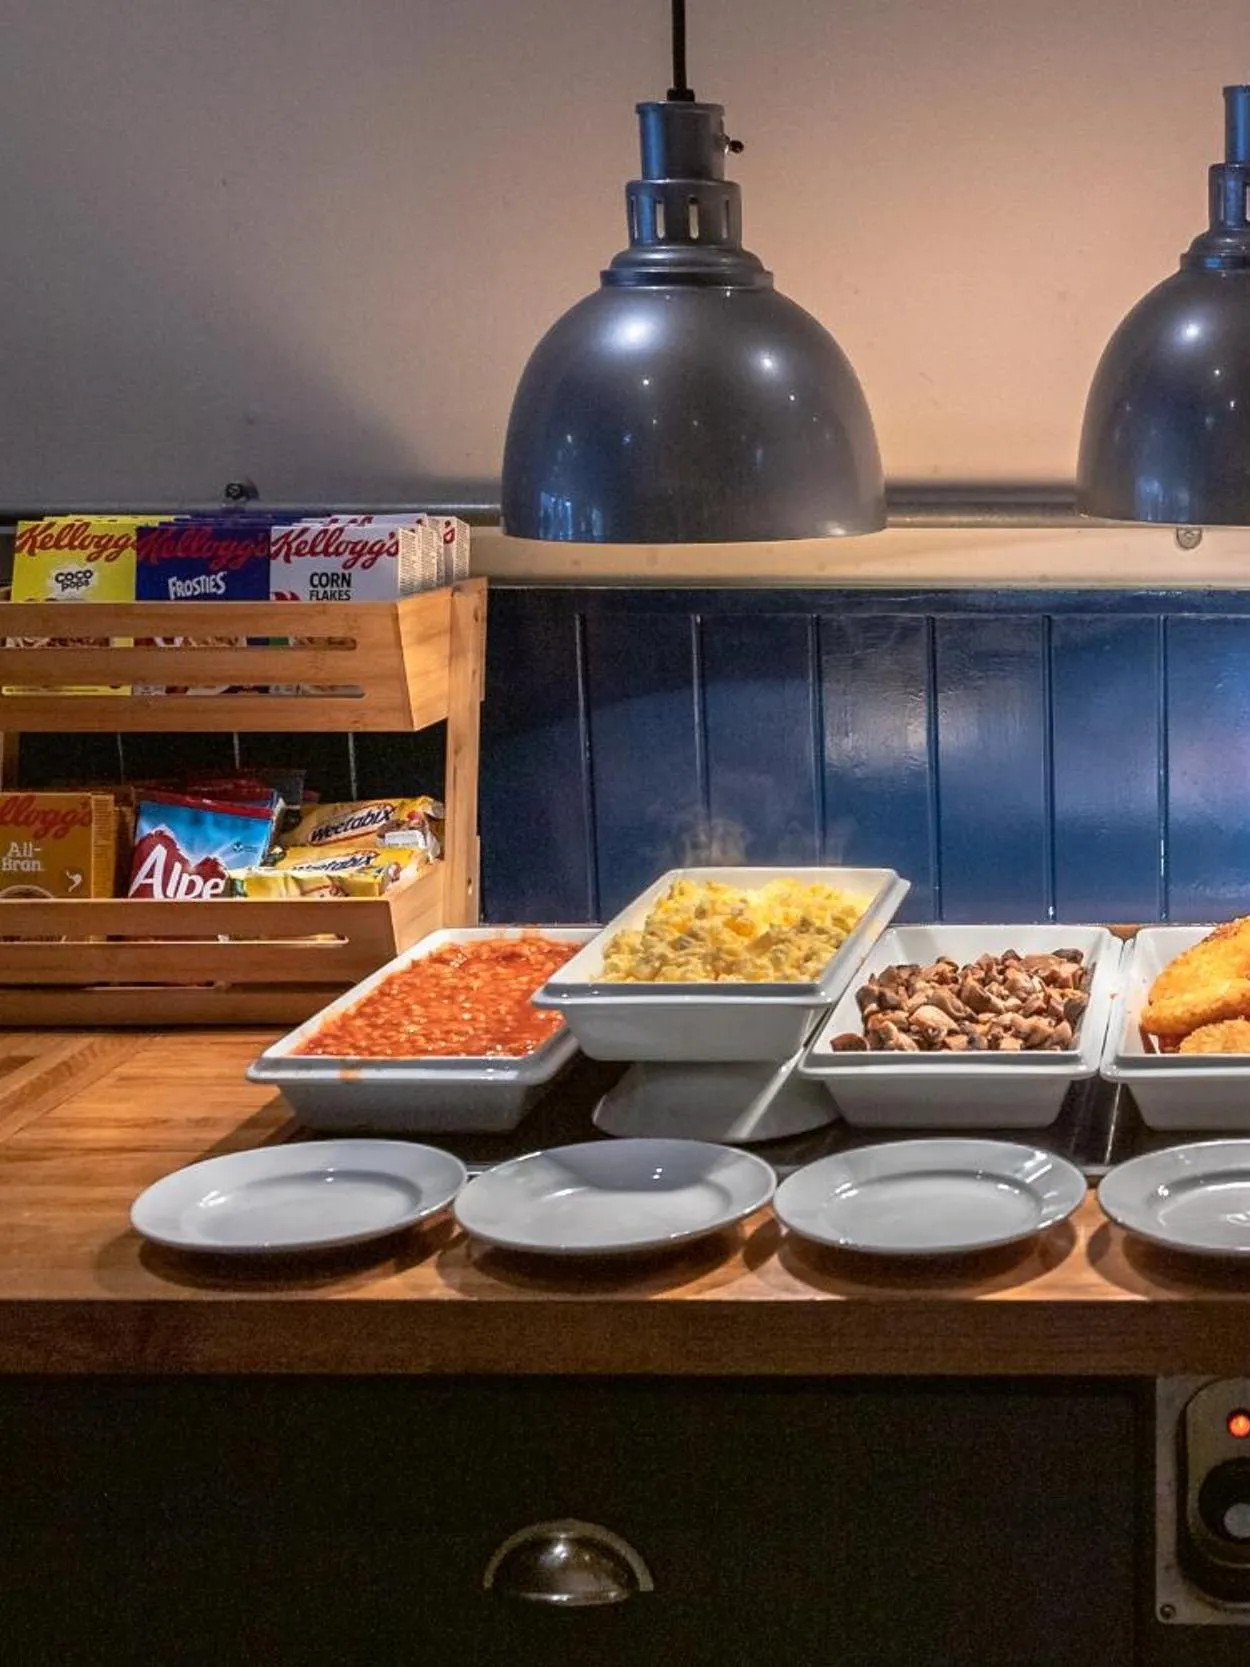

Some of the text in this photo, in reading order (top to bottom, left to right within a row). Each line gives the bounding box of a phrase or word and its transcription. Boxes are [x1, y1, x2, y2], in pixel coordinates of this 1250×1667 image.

[15, 521, 137, 562] Kellogg
[270, 527, 399, 570] Kellogg's
[168, 571, 228, 600] FROSTIES
[309, 572, 352, 588] CORN
[309, 589, 351, 601] FLAKES
[0, 794, 92, 840] llogg's
[310, 807, 394, 842] Weetabix
[2, 857, 42, 872] Bran
[7, 841, 41, 857] All-
[128, 843, 226, 899] Alpe
